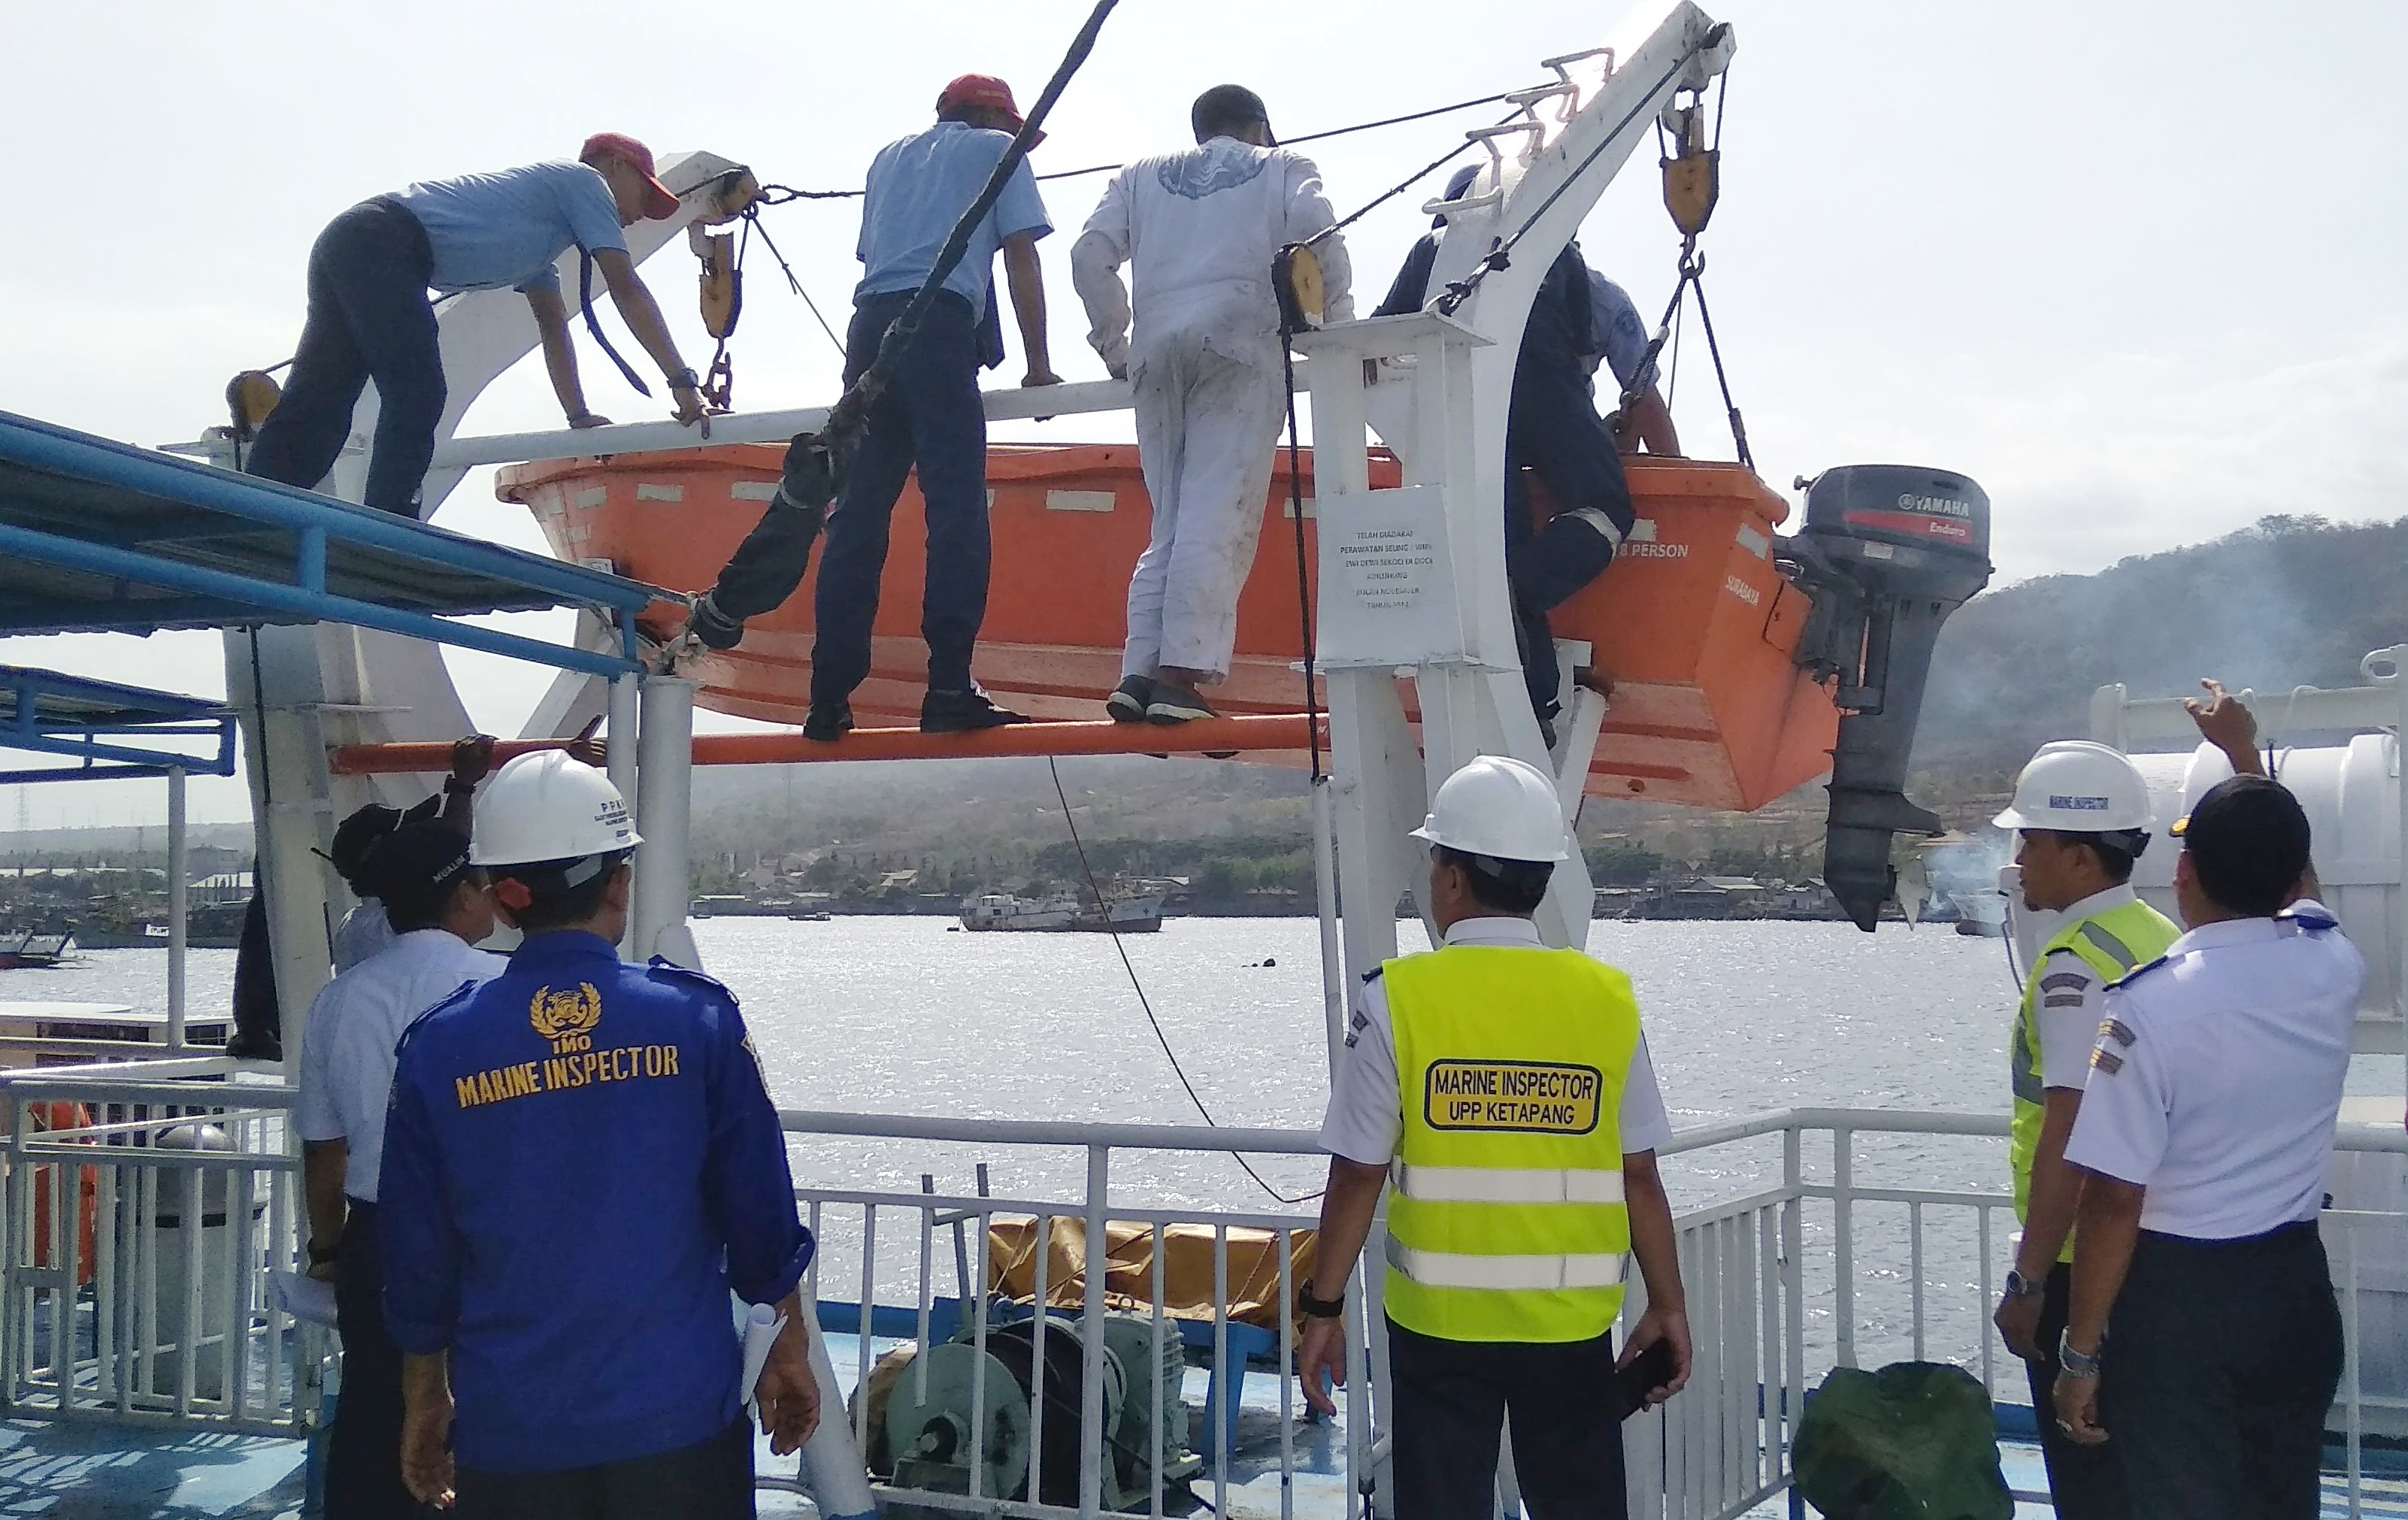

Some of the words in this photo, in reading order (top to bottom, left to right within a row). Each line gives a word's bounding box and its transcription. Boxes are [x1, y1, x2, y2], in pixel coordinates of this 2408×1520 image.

[1916, 495, 1969, 516] YAMAHA
[1929, 522, 1966, 537] Enduro
[1340, 545, 1383, 554] PERAWATAN
[1385, 544, 1408, 553] SELING
[1632, 544, 1689, 558] PERSON
[1726, 575, 1760, 606] SURABAYA
[553, 1035, 592, 1054] IMO
[455, 1061, 542, 1109] MARINE
[543, 1045, 680, 1091] INSPECTOR
[1434, 1069, 1498, 1095] MARINE
[1502, 1070, 1594, 1100] INSPECTOR
[1449, 1101, 1482, 1122] UPP
[1487, 1101, 1575, 1125] KETAPANG
